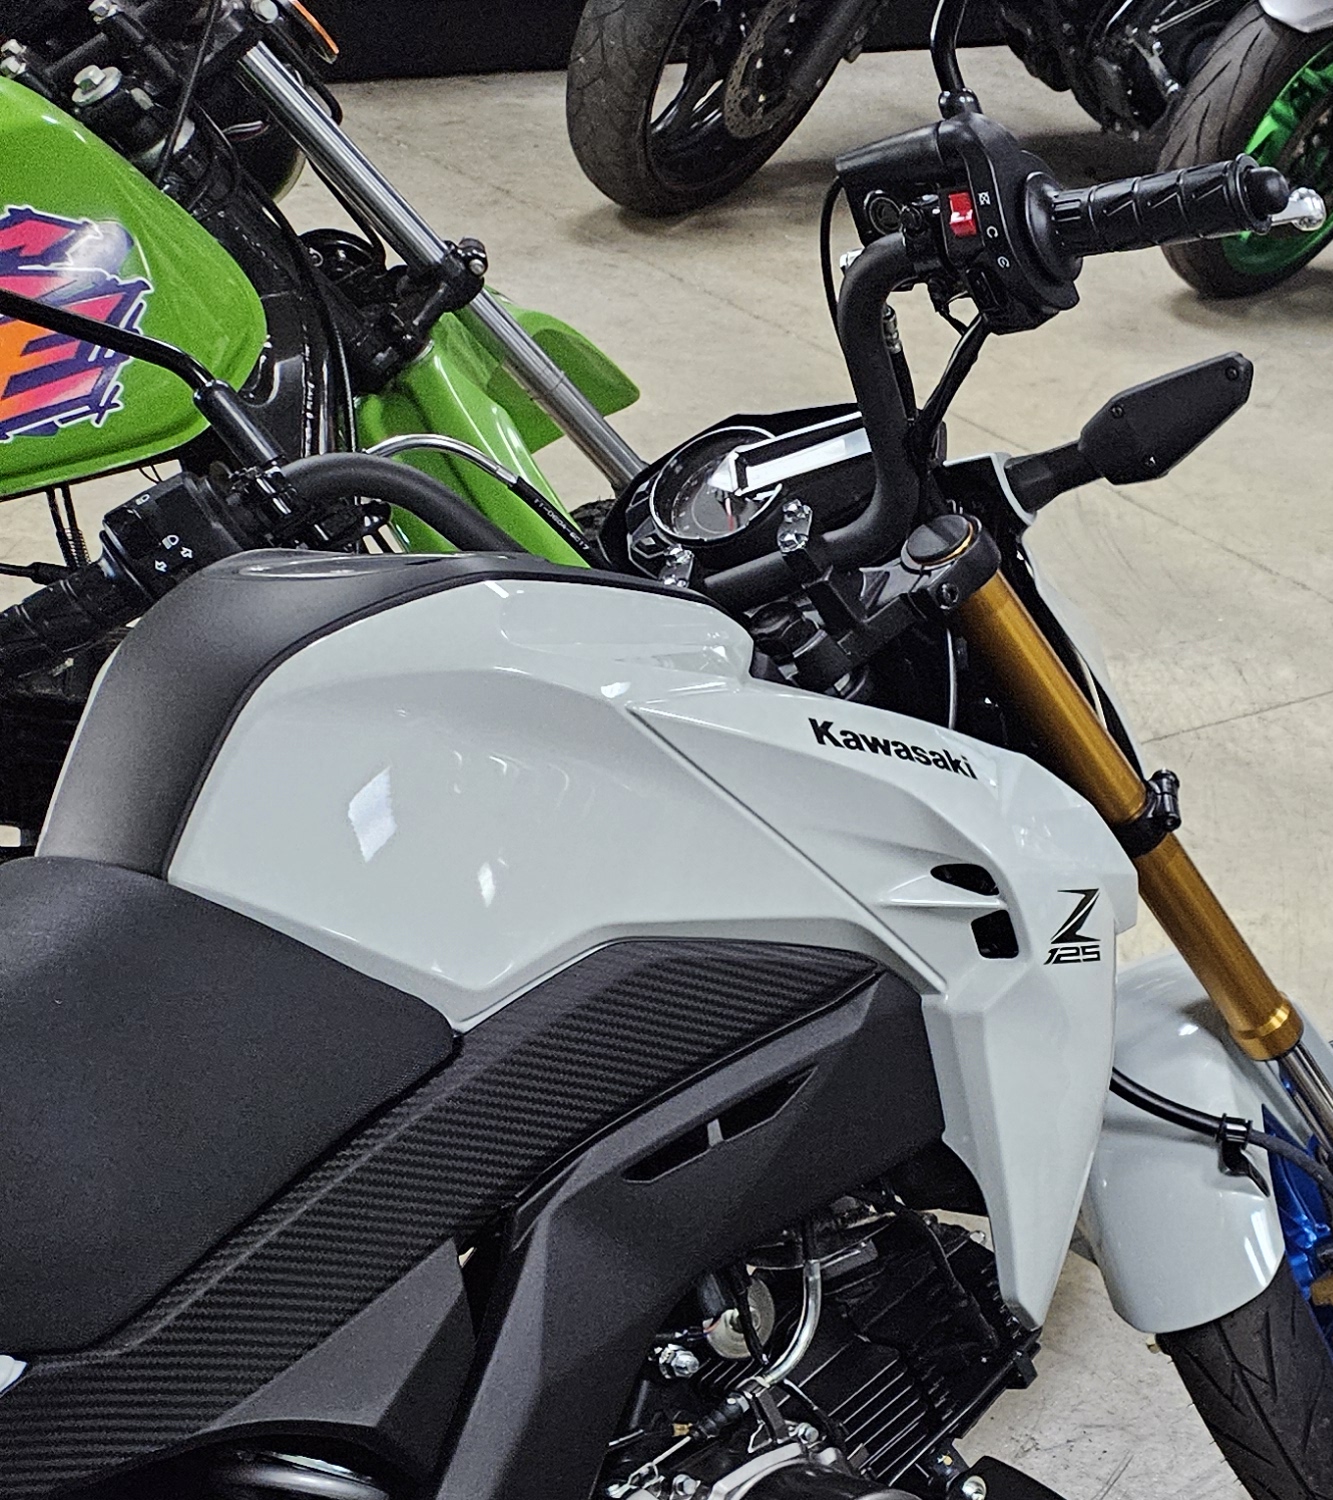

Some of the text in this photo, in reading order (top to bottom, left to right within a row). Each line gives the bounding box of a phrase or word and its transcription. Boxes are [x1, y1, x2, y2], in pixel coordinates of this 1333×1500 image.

[808, 717, 978, 780] Kawasaki
[1049, 888, 1102, 944] Z
[1043, 945, 1101, 965] 125
